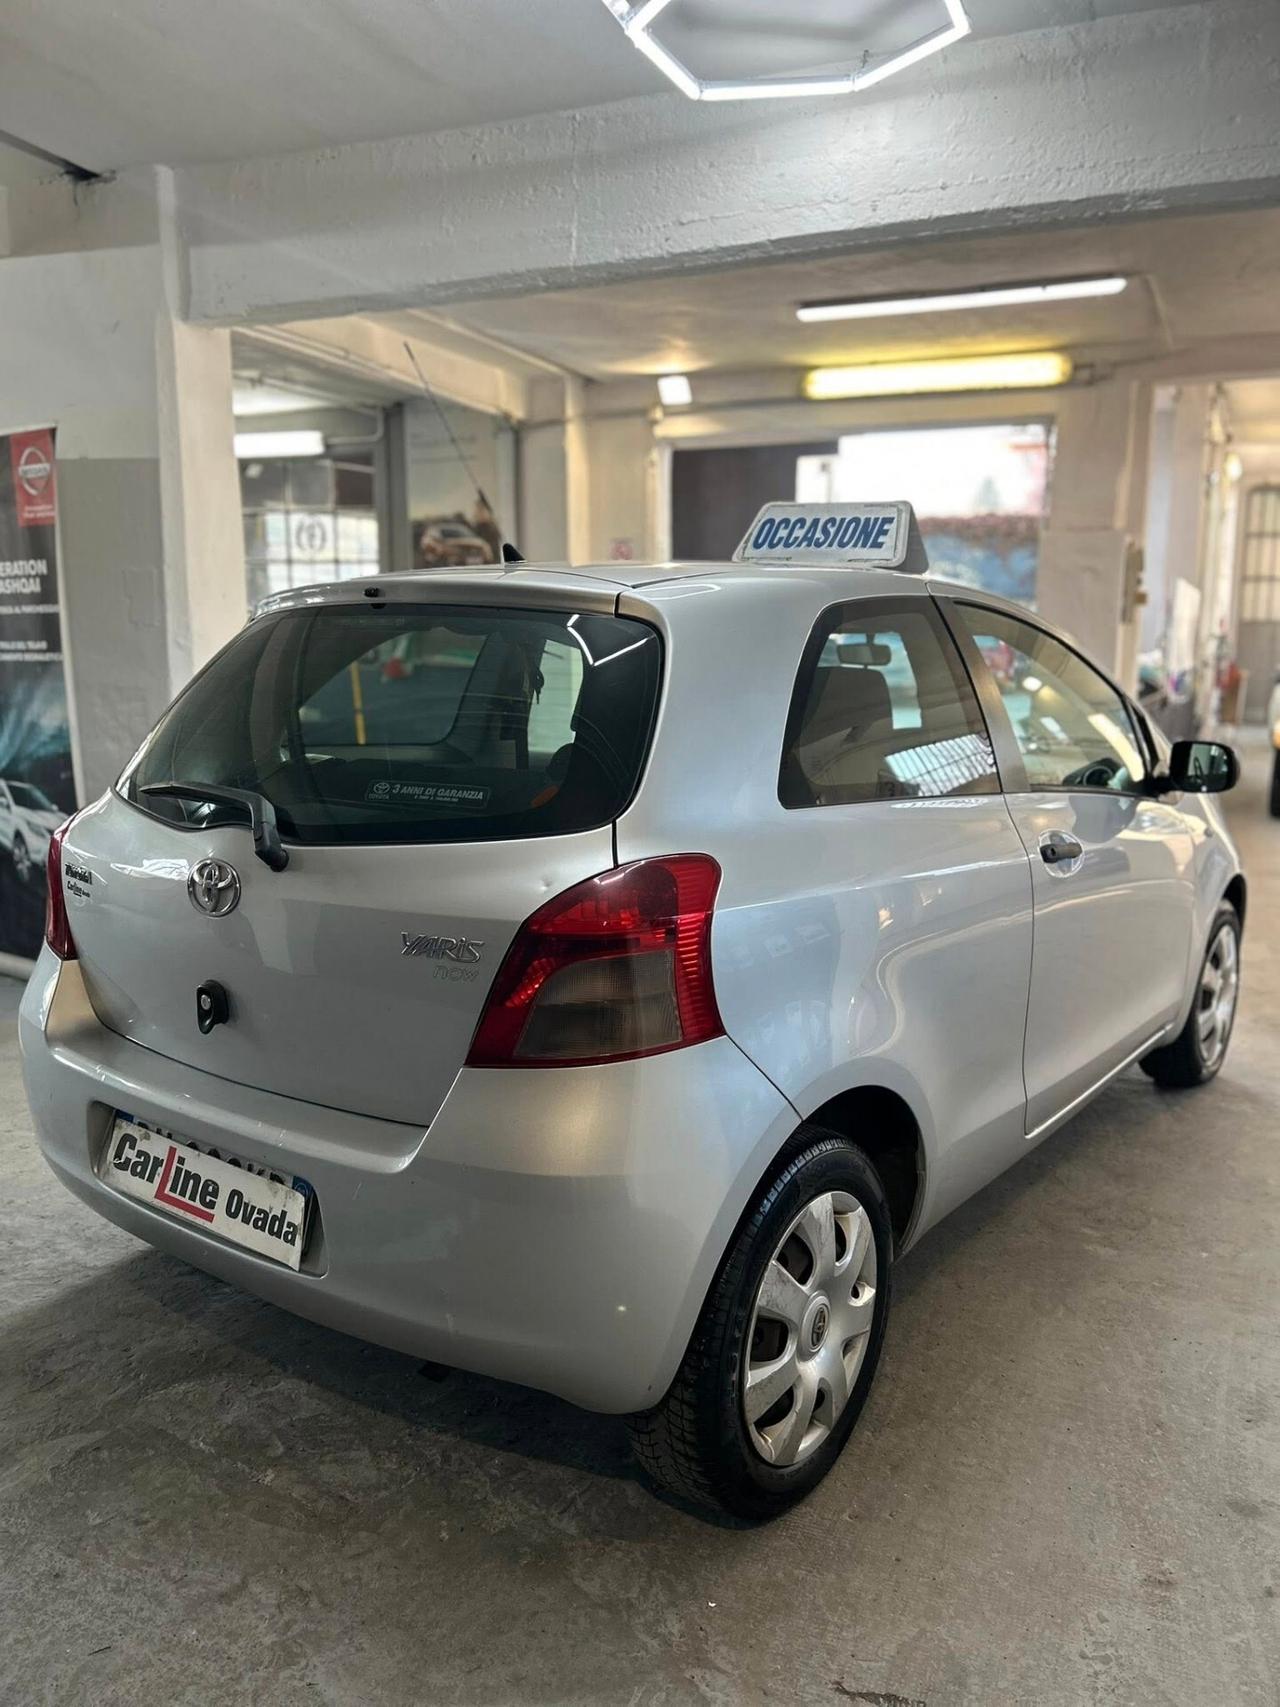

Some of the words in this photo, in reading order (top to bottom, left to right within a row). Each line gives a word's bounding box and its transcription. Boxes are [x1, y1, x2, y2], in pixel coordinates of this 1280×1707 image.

[752, 516, 896, 550] OCCASIONE
[392, 784, 400, 794] 3
[401, 786, 423, 795] ANNI
[424, 788, 436, 796] DI
[437, 788, 483, 800] GARANZIA
[225, 1188, 299, 1247] Ovada
